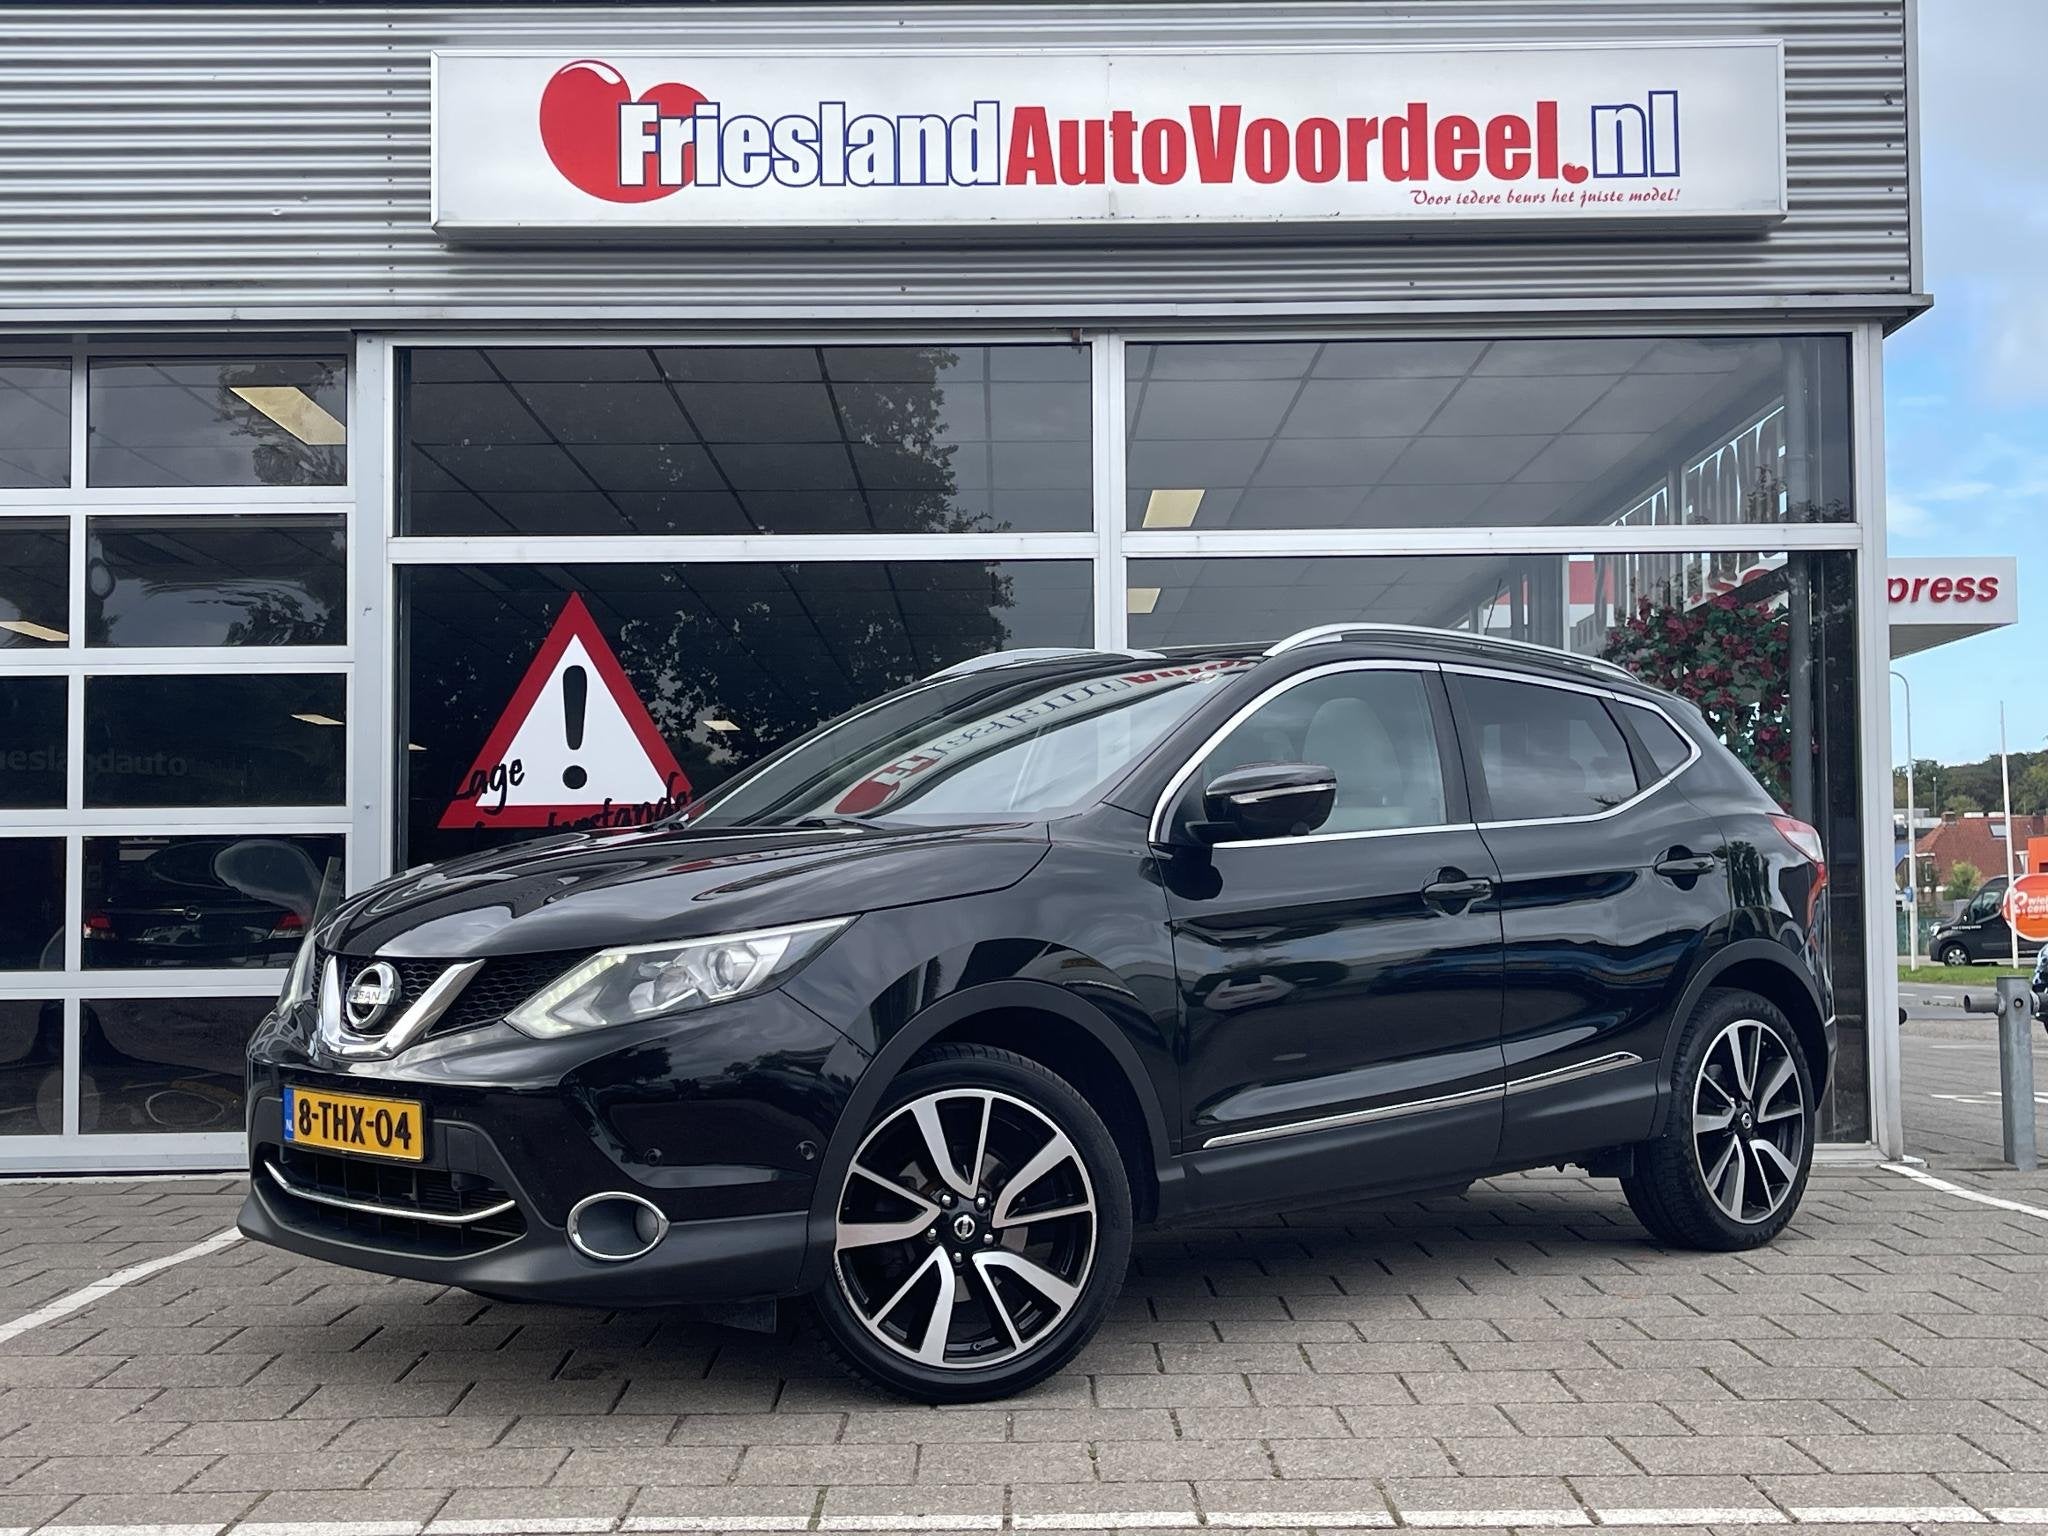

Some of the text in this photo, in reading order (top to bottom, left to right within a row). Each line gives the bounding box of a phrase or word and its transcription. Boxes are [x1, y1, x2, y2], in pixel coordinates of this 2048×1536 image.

[1410, 187, 1681, 208] Voor iedere beurs het juiste model!
[456, 758, 525, 815] age
[298, 1098, 411, 1150] 8-THX-04
